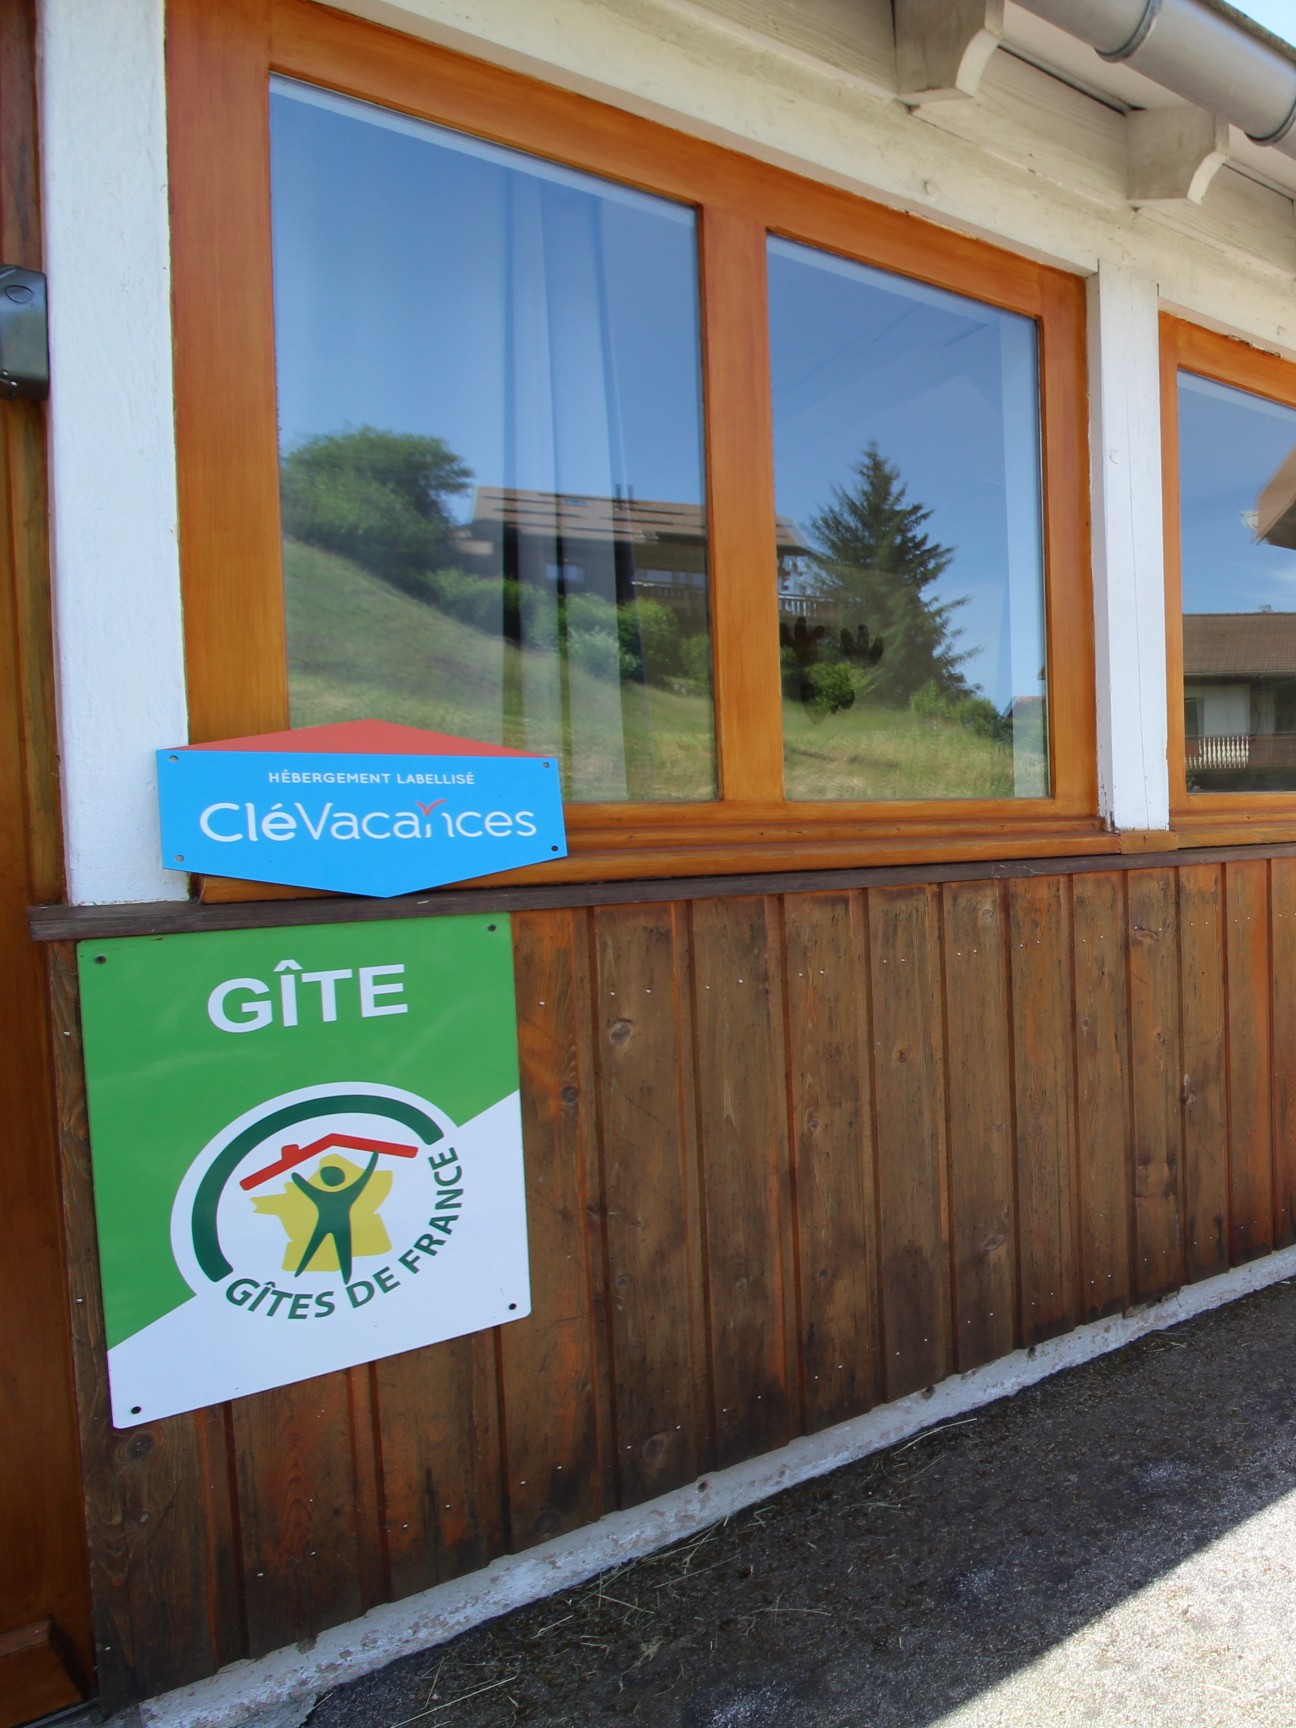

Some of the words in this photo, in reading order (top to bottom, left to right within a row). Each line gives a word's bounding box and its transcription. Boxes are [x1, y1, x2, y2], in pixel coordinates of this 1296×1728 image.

[268, 768, 390, 785] HÉBERGEMENT
[396, 771, 475, 785] LABELLISÉ
[207, 959, 409, 1033] GÎTE
[225, 1277, 335, 1320] GÎTES
[345, 1266, 401, 1309] DE
[398, 1146, 464, 1275] FRANCE
